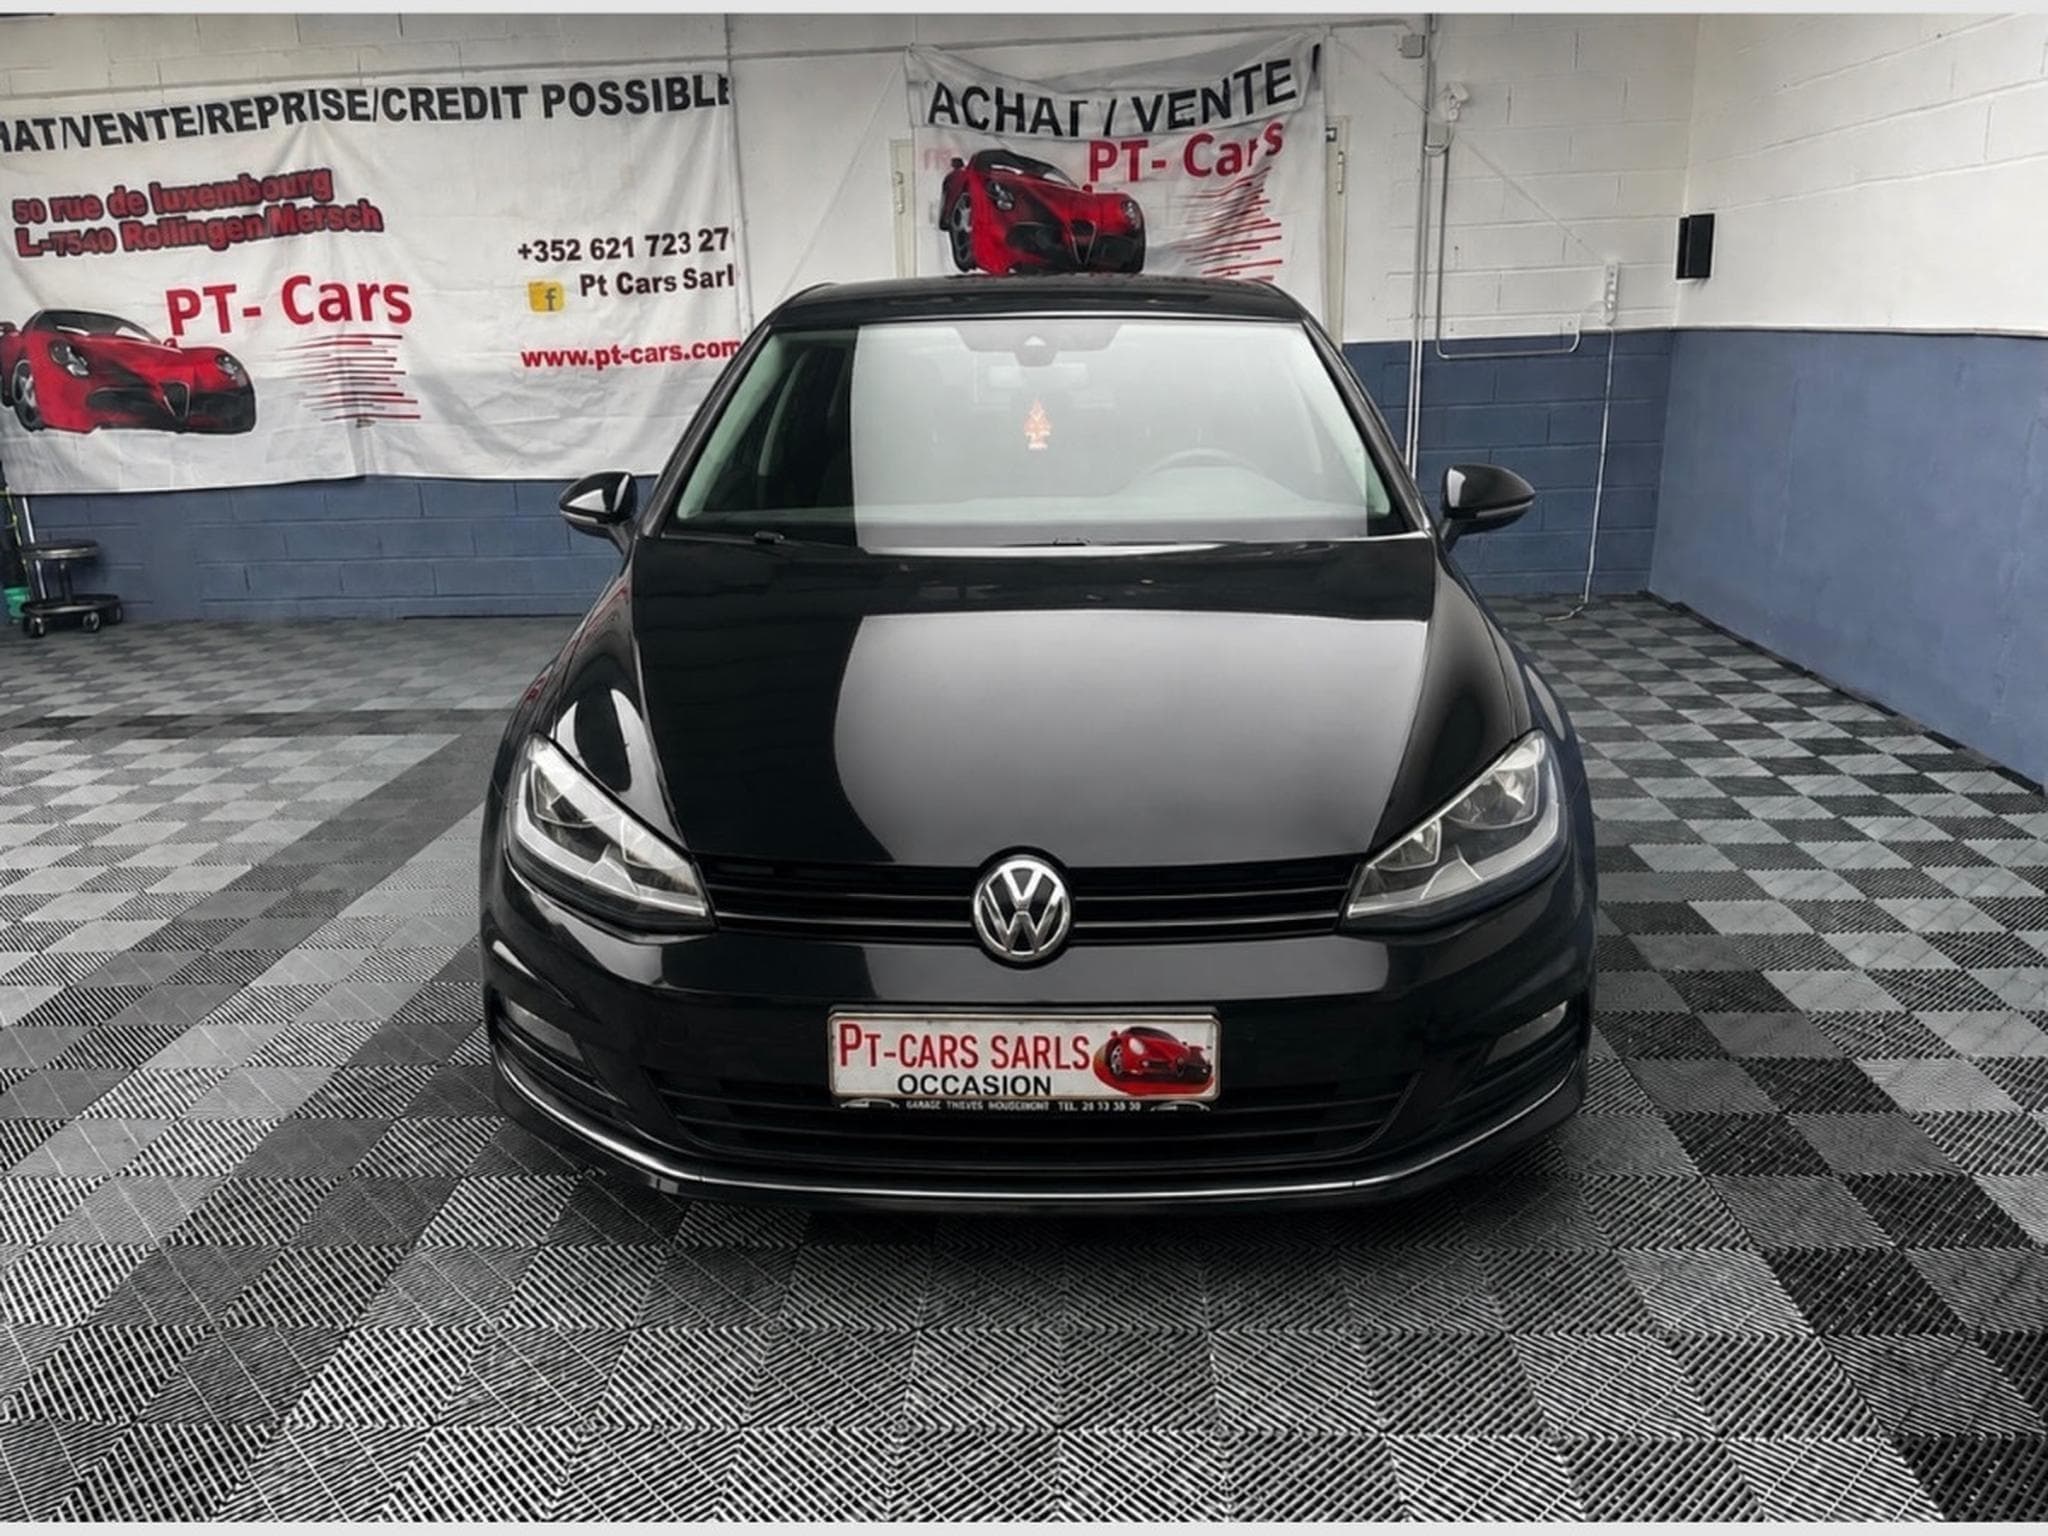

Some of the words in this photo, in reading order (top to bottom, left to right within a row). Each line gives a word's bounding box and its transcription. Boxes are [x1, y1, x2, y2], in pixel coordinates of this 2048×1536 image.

[927, 82, 1087, 137] ACHAT
[1103, 98, 1117, 136] /
[1131, 58, 1297, 133] VENTE
[1088, 139, 1167, 182] PT-
[1183, 121, 1284, 178] Cars
[12, 198, 47, 224] 50
[48, 195, 104, 222] rue
[106, 185, 149, 219] de
[148, 168, 334, 215] luxembourg
[14, 227, 117, 258] L-7540
[517, 239, 582, 263] +352
[589, 236, 635, 261] 621
[645, 232, 692, 258] 723
[698, 227, 730, 252] 27
[579, 274, 608, 297] Pt
[615, 271, 678, 296] Cars
[682, 264, 735, 290] Sarl
[165, 284, 262, 335] PT-
[281, 274, 413, 324] Cars
[520, 339, 742, 371] www.pt-cars.com
[838, 1023, 979, 1069] PT-CARS
[990, 1034, 1091, 1071] SARLS
[896, 1073, 1053, 1097] OCCASION
